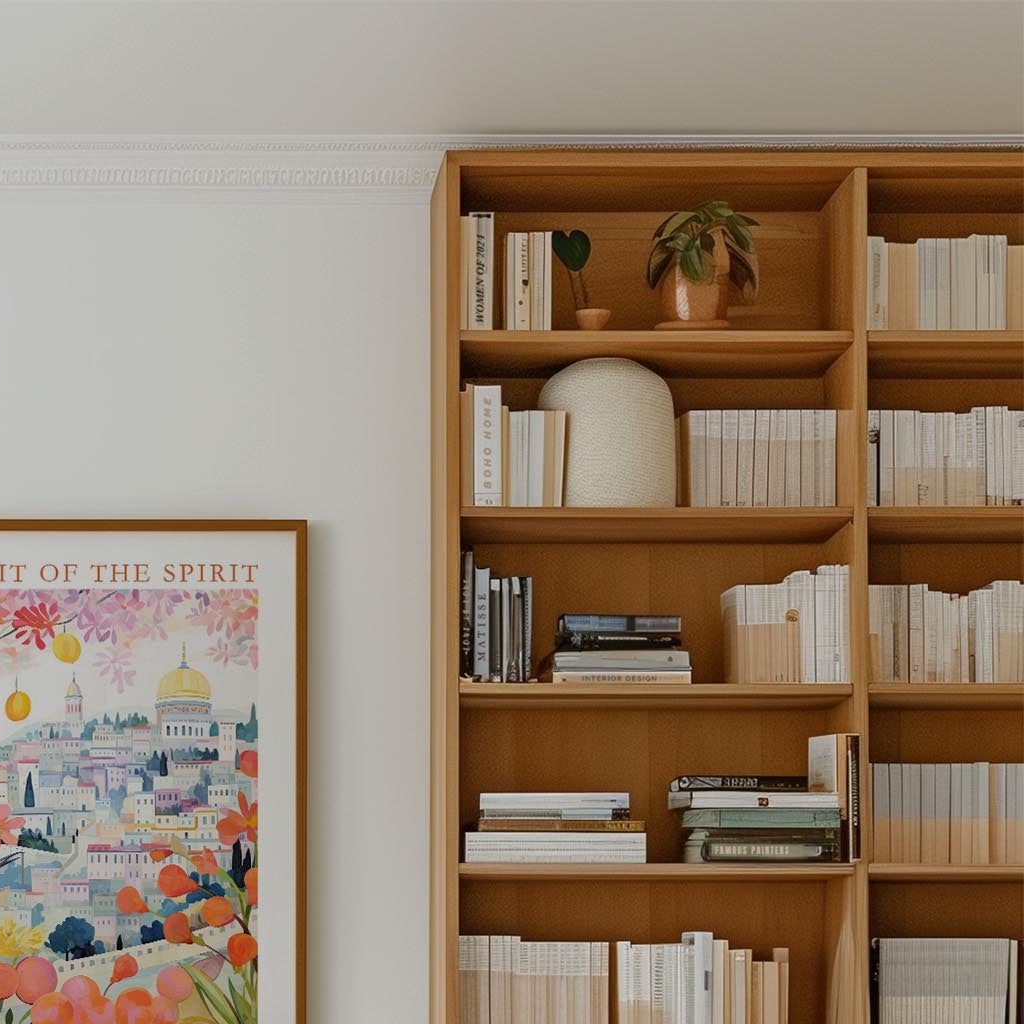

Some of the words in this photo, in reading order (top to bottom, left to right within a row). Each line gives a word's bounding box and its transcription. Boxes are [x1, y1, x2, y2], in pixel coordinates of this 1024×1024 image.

[475, 258, 485, 276] OF
[475, 278, 485, 323] WOMEN
[483, 397, 492, 440] HOME
[483, 447, 492, 489] BOHO
[39, 563, 78, 583] OF
[90, 563, 151, 583] THE
[163, 563, 259, 583] SPIRIT
[477, 593, 486, 661] MATISSE
[582, 674, 622, 682] INTERIOR
[625, 674, 657, 682] DESIGN
[714, 845, 747, 855] FAMOUS
[750, 845, 789, 855] PAINTERS
